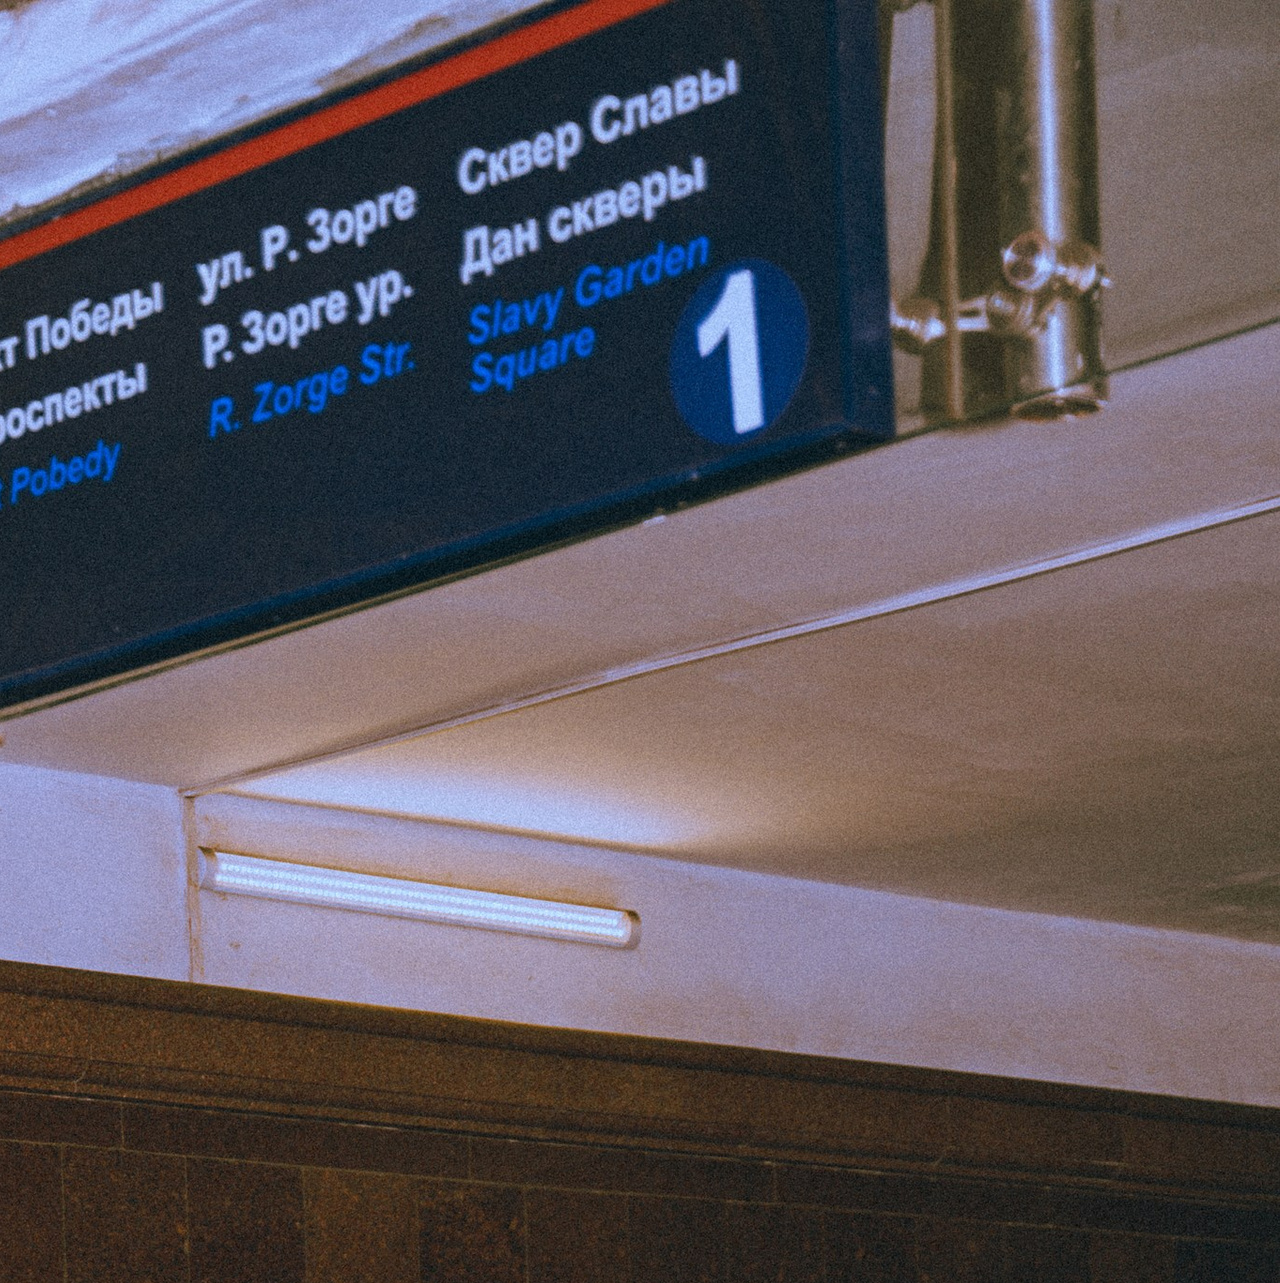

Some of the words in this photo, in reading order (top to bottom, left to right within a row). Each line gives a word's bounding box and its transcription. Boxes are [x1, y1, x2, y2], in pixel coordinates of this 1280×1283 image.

[458, 122, 582, 194] Сквер
[591, 60, 738, 144] Славы
[197, 251, 254, 306] ул.
[261, 225, 299, 271] Р.
[307, 186, 416, 253] Зорге
[461, 218, 539, 285] Дан
[548, 157, 706, 243] скверы
[26, 282, 163, 360] Победы
[203, 324, 234, 369] Р.
[241, 290, 348, 354] Зорге
[355, 270, 413, 325] ур.
[467, 287, 564, 346] Slavy
[574, 235, 710, 308] Garden
[209, 396, 242, 438] R.
[251, 364, 350, 423] Zorge
[359, 342, 415, 386] Str.
[469, 326, 596, 394] Square
[698, 270, 763, 433] 1
[10, 439, 121, 504] Pobedy
